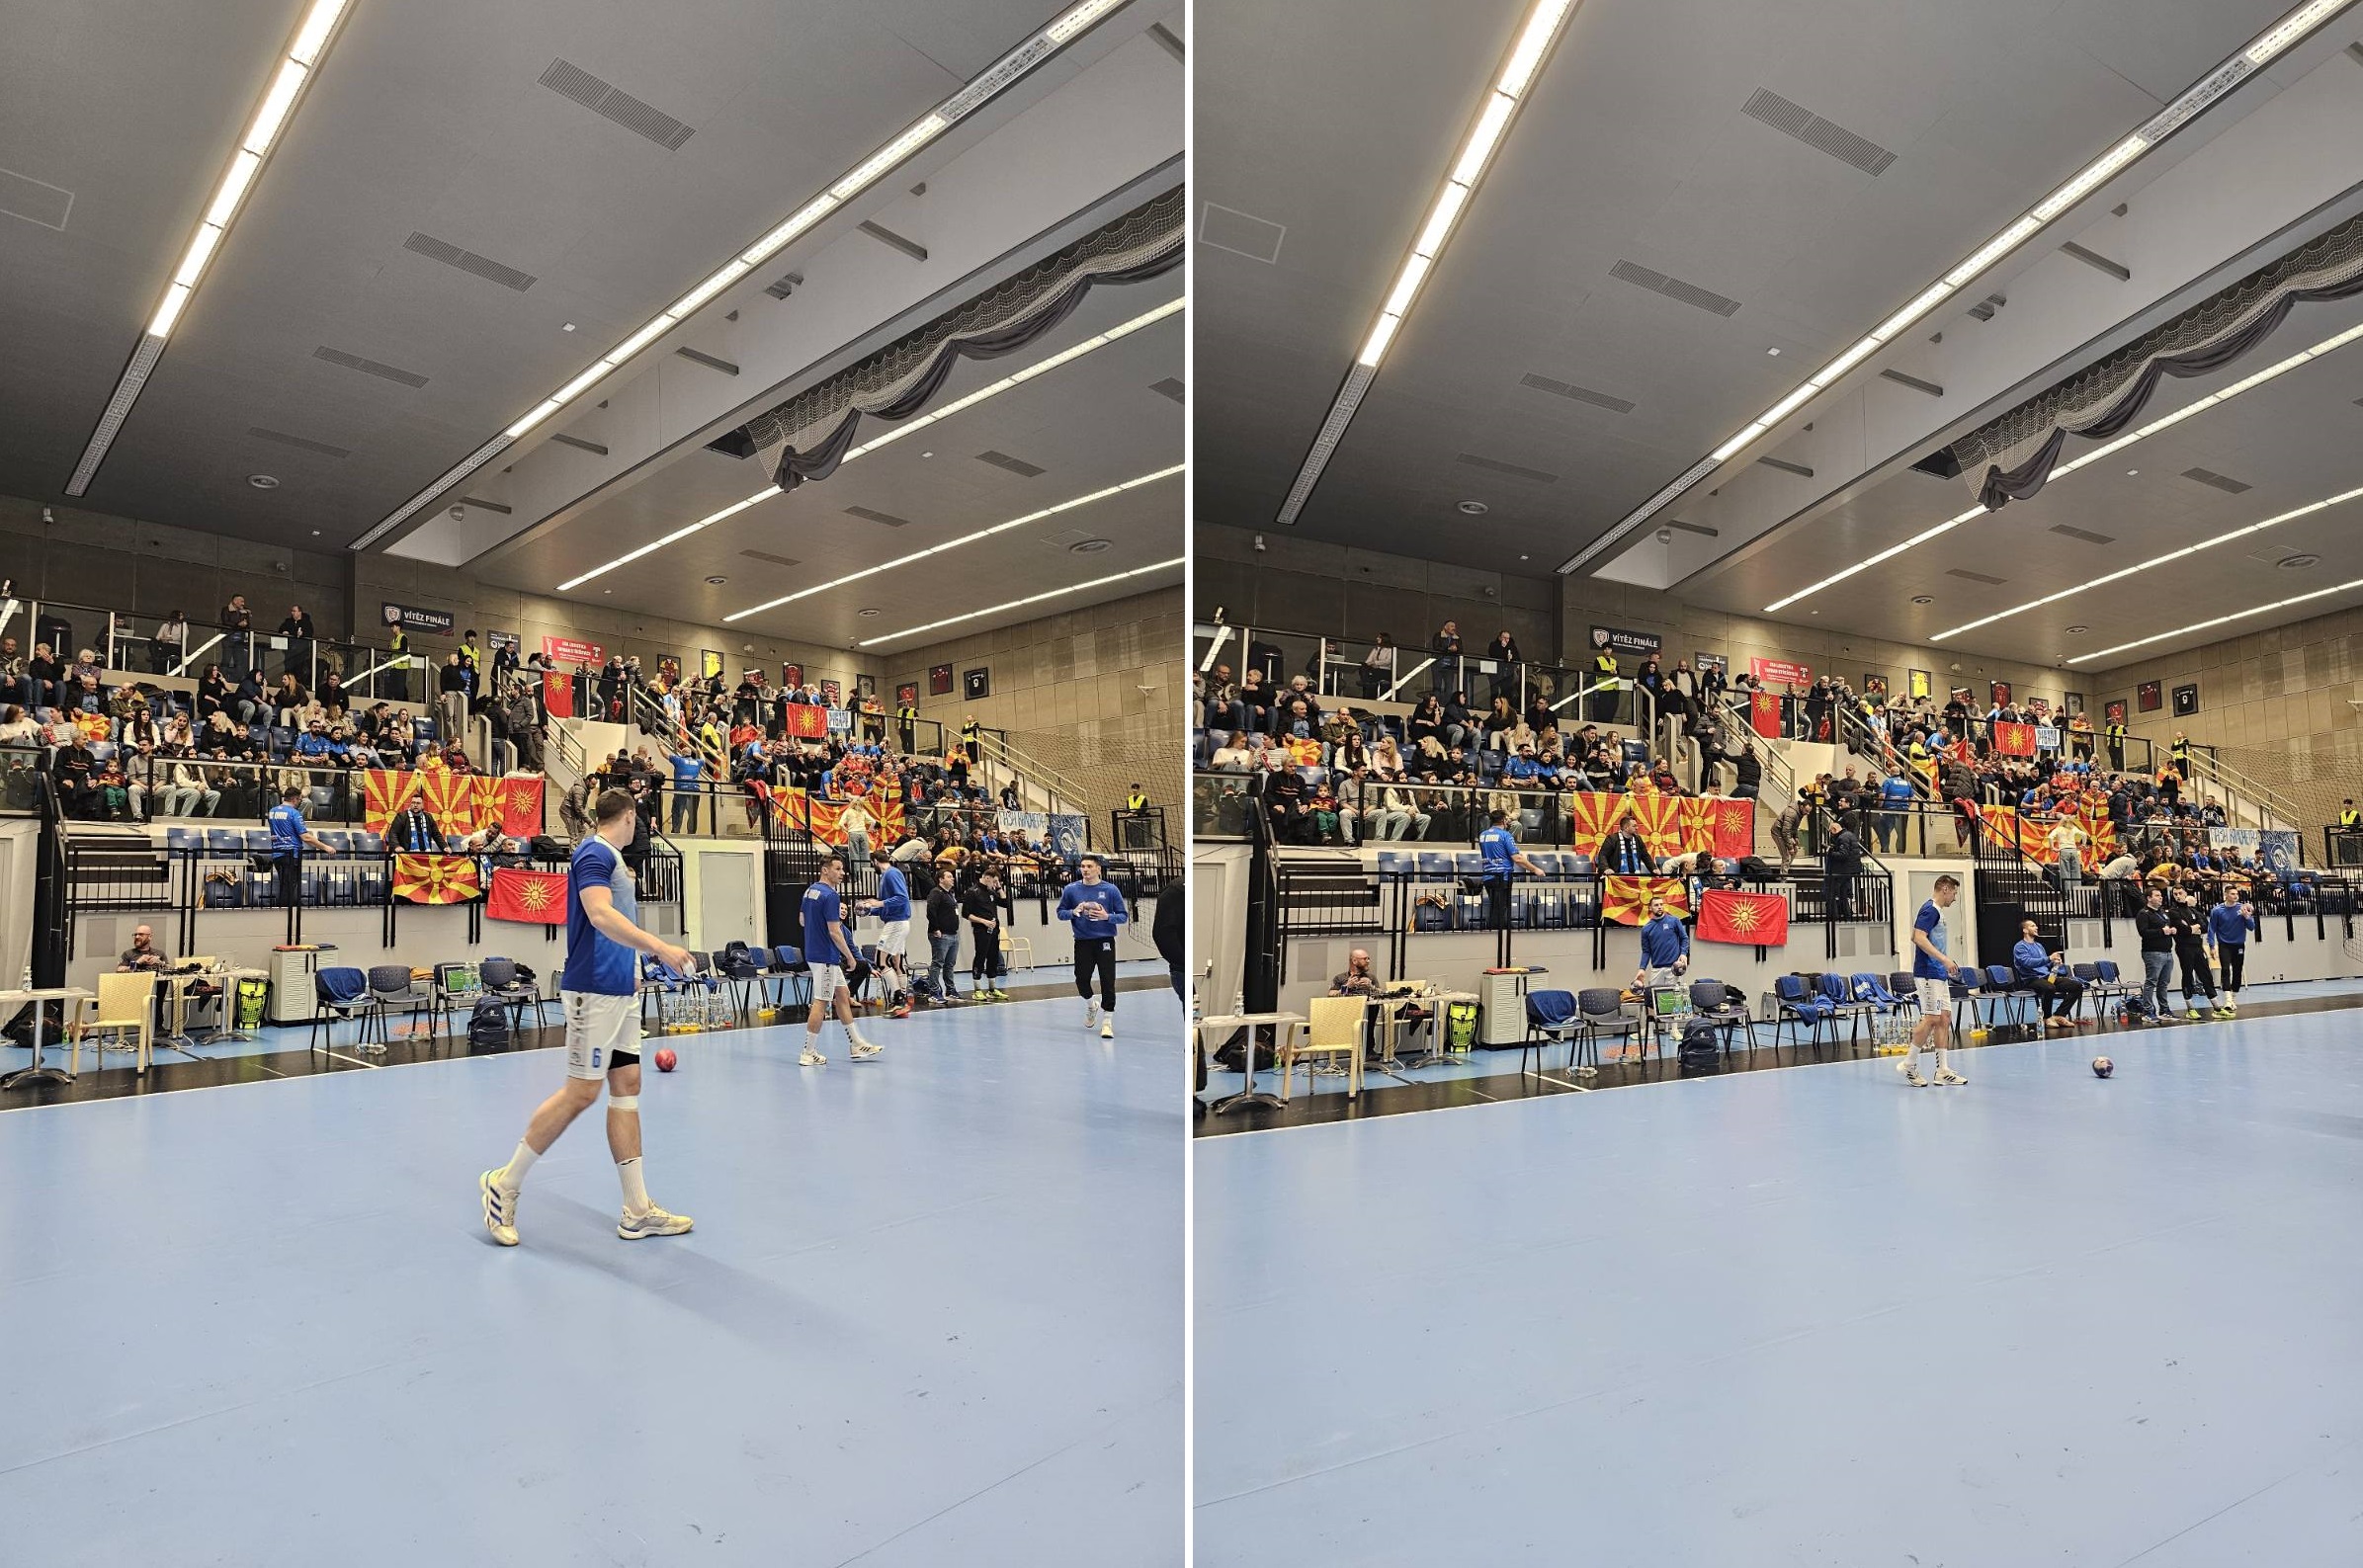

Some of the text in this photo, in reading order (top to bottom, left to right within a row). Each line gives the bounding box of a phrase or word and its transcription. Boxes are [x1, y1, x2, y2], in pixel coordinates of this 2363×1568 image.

[425, 615, 451, 626] FINÁLE
[1633, 637, 1658, 648] FINÁLE
[593, 1047, 601, 1068] 6
